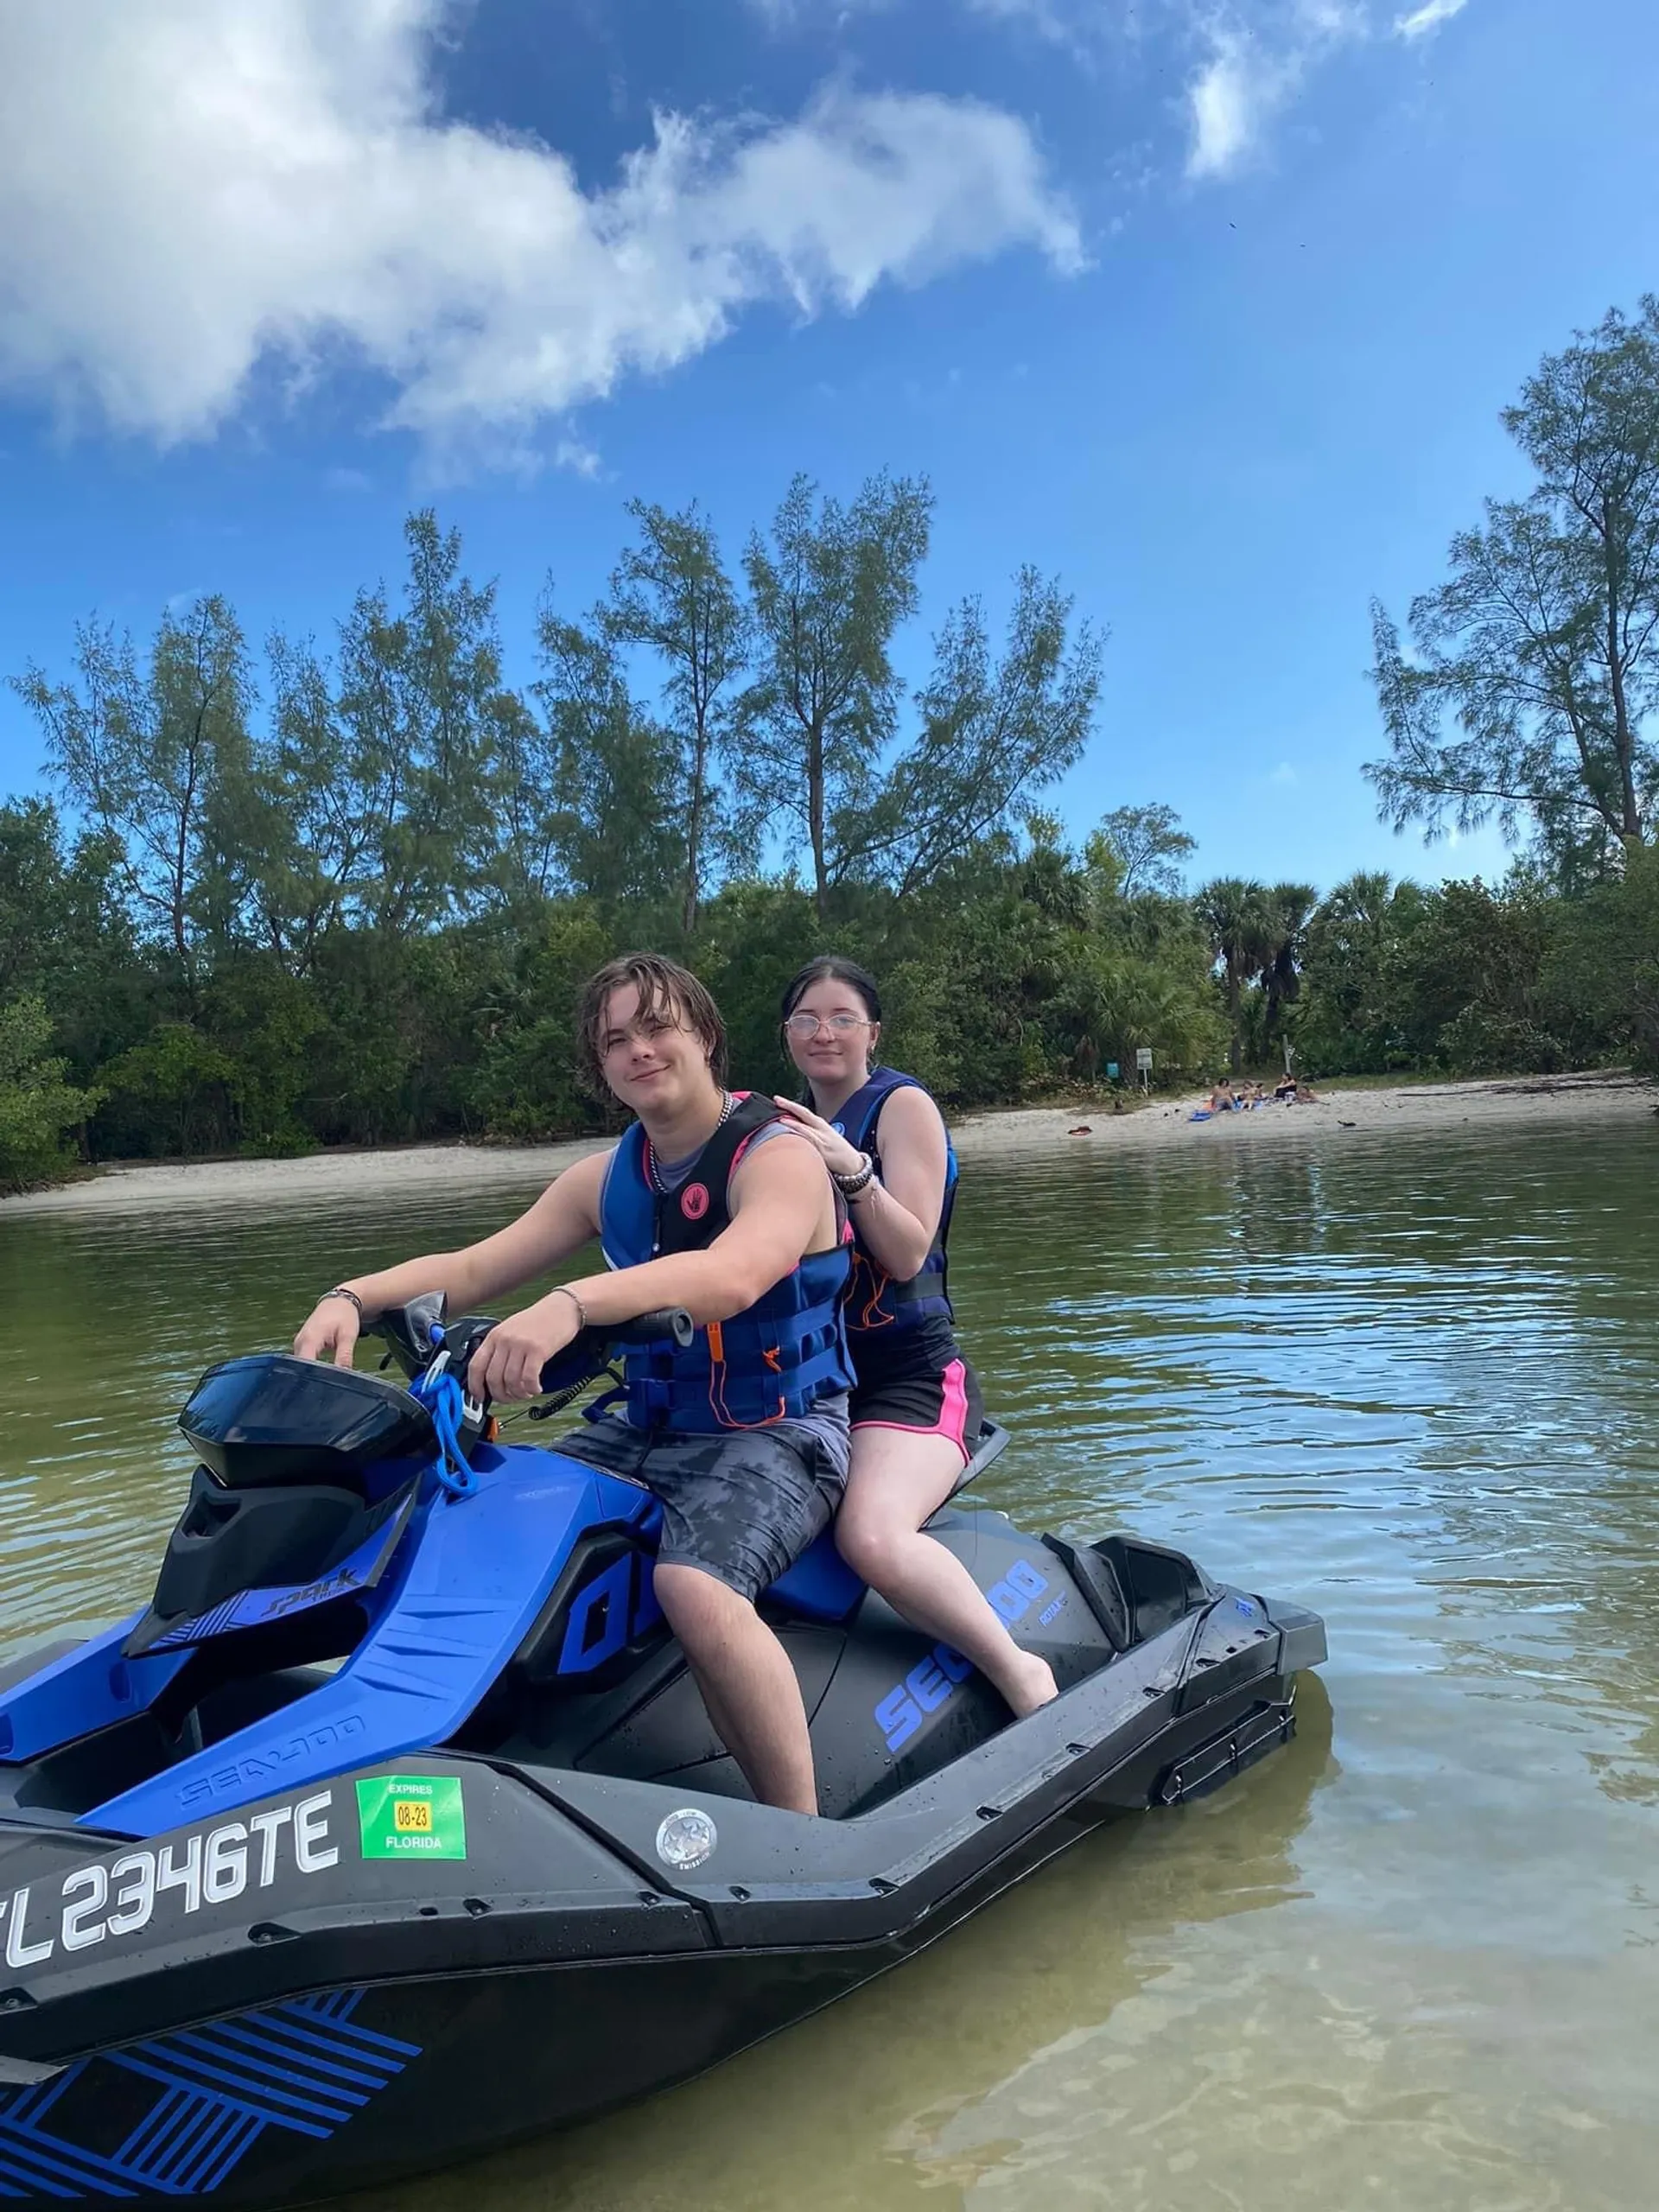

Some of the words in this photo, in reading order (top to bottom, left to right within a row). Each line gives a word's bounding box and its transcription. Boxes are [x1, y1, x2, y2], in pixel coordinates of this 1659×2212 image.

[388, 1783, 433, 1795] EXPIRES
[398, 1805, 428, 1826] 08-23
[385, 1836, 442, 1849] FLORIDA
[0, 1789, 339, 1968] L2346TE
